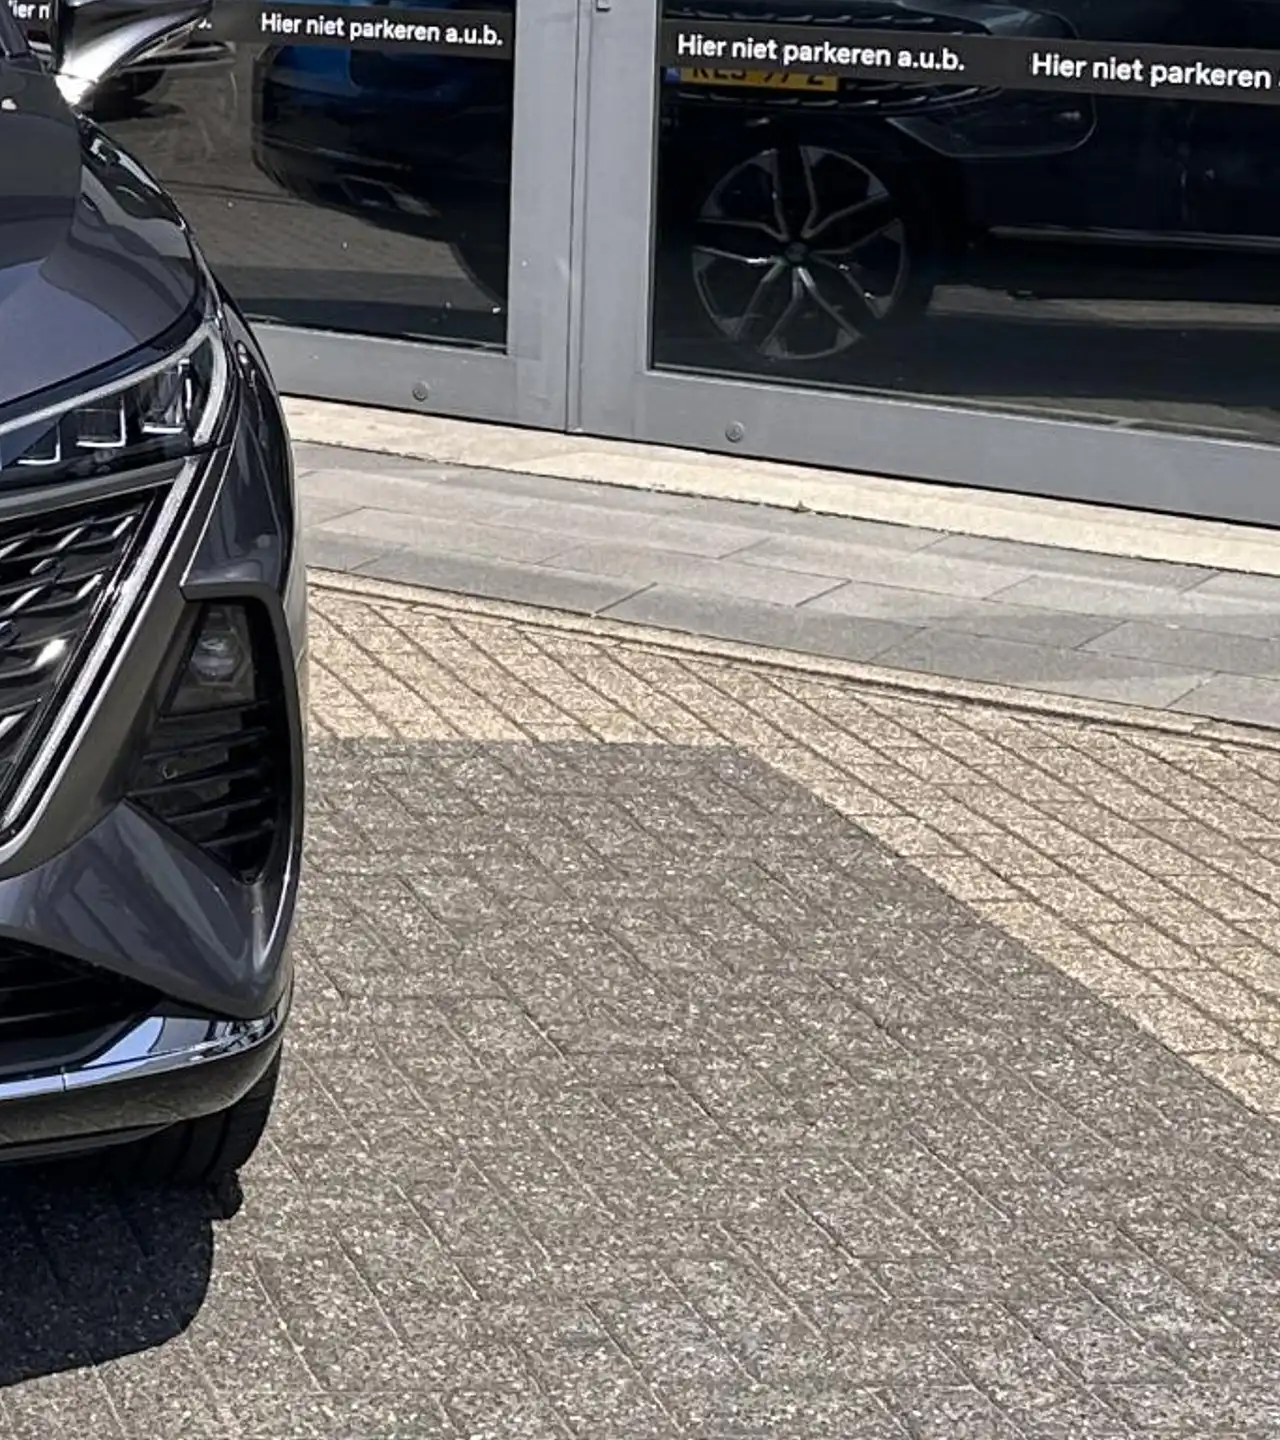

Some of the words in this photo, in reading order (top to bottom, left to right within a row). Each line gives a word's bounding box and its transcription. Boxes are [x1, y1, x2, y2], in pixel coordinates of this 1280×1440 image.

[260, 12, 302, 34] Hier
[306, 15, 345, 36] niet
[350, 19, 440, 41] parkeren
[445, 24, 503, 46] a.u.b.
[677, 33, 726, 57] Hier
[731, 37, 778, 60] niet
[783, 41, 891, 66] parkeren
[897, 47, 965, 71] a.u.b.
[1032, 52, 1088, 78] Hier
[1092, 57, 1144, 81] niet
[1149, 61, 1272, 90] parkeren
